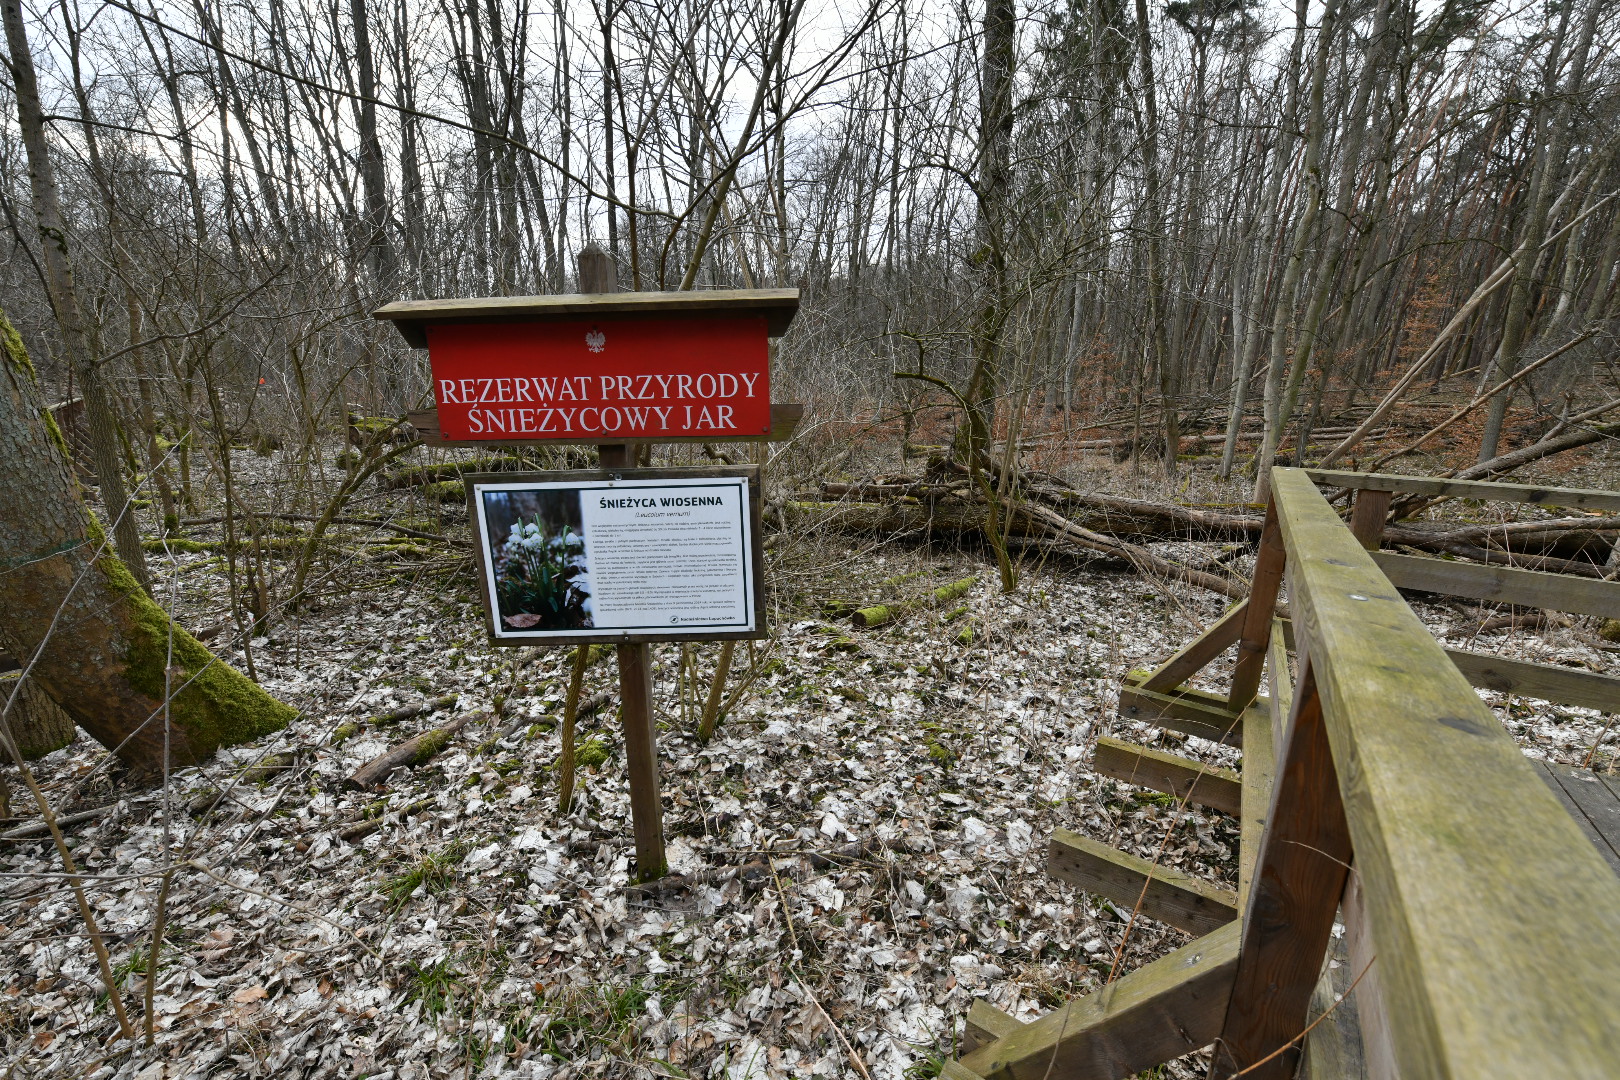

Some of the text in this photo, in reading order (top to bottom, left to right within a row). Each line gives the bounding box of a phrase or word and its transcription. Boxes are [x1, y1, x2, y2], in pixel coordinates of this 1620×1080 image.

[439, 372, 760, 404] REZERWAT PRZYRODY
[468, 403, 738, 433] ŚNIEŻYCOWY JAR
[599, 496, 724, 509] ŚNIEŻYCA WIOSENNA
